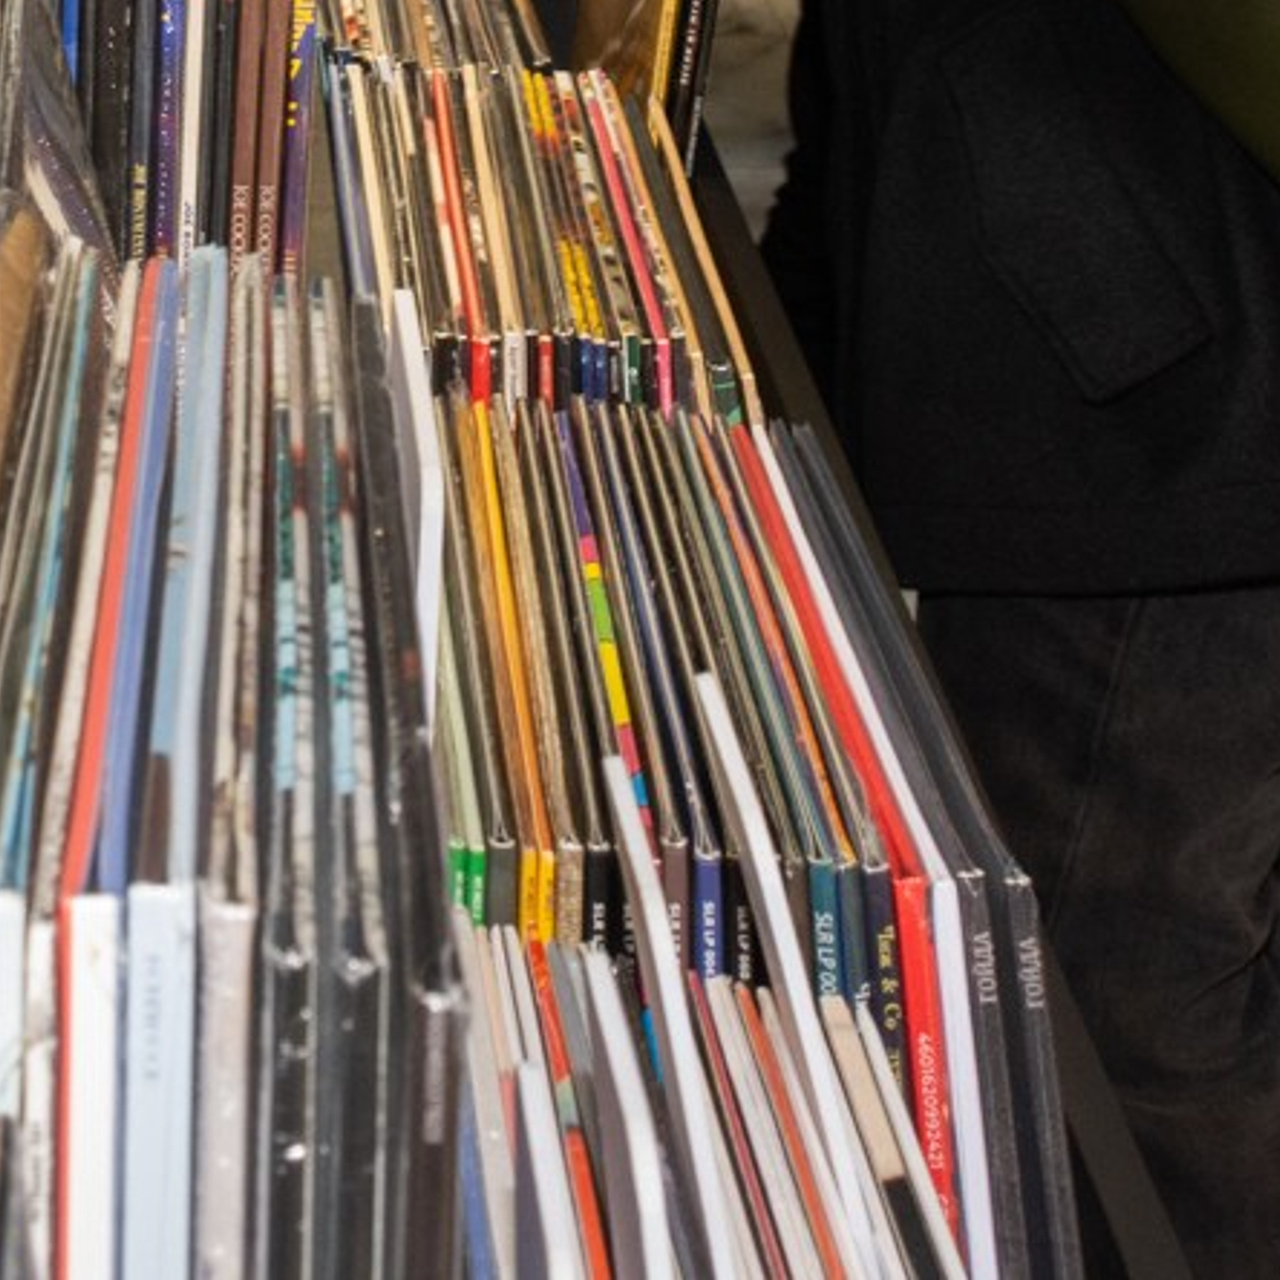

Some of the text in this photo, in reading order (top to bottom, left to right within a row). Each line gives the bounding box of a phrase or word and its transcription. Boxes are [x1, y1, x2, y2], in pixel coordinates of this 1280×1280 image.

[815, 910, 834, 944] SLR
[818, 948, 836, 969] LP
[973, 930, 998, 1003] ГОЙДА
[1018, 936, 1046, 1009] ГОЙДА
[917, 1032, 944, 1171] 4601620992421
